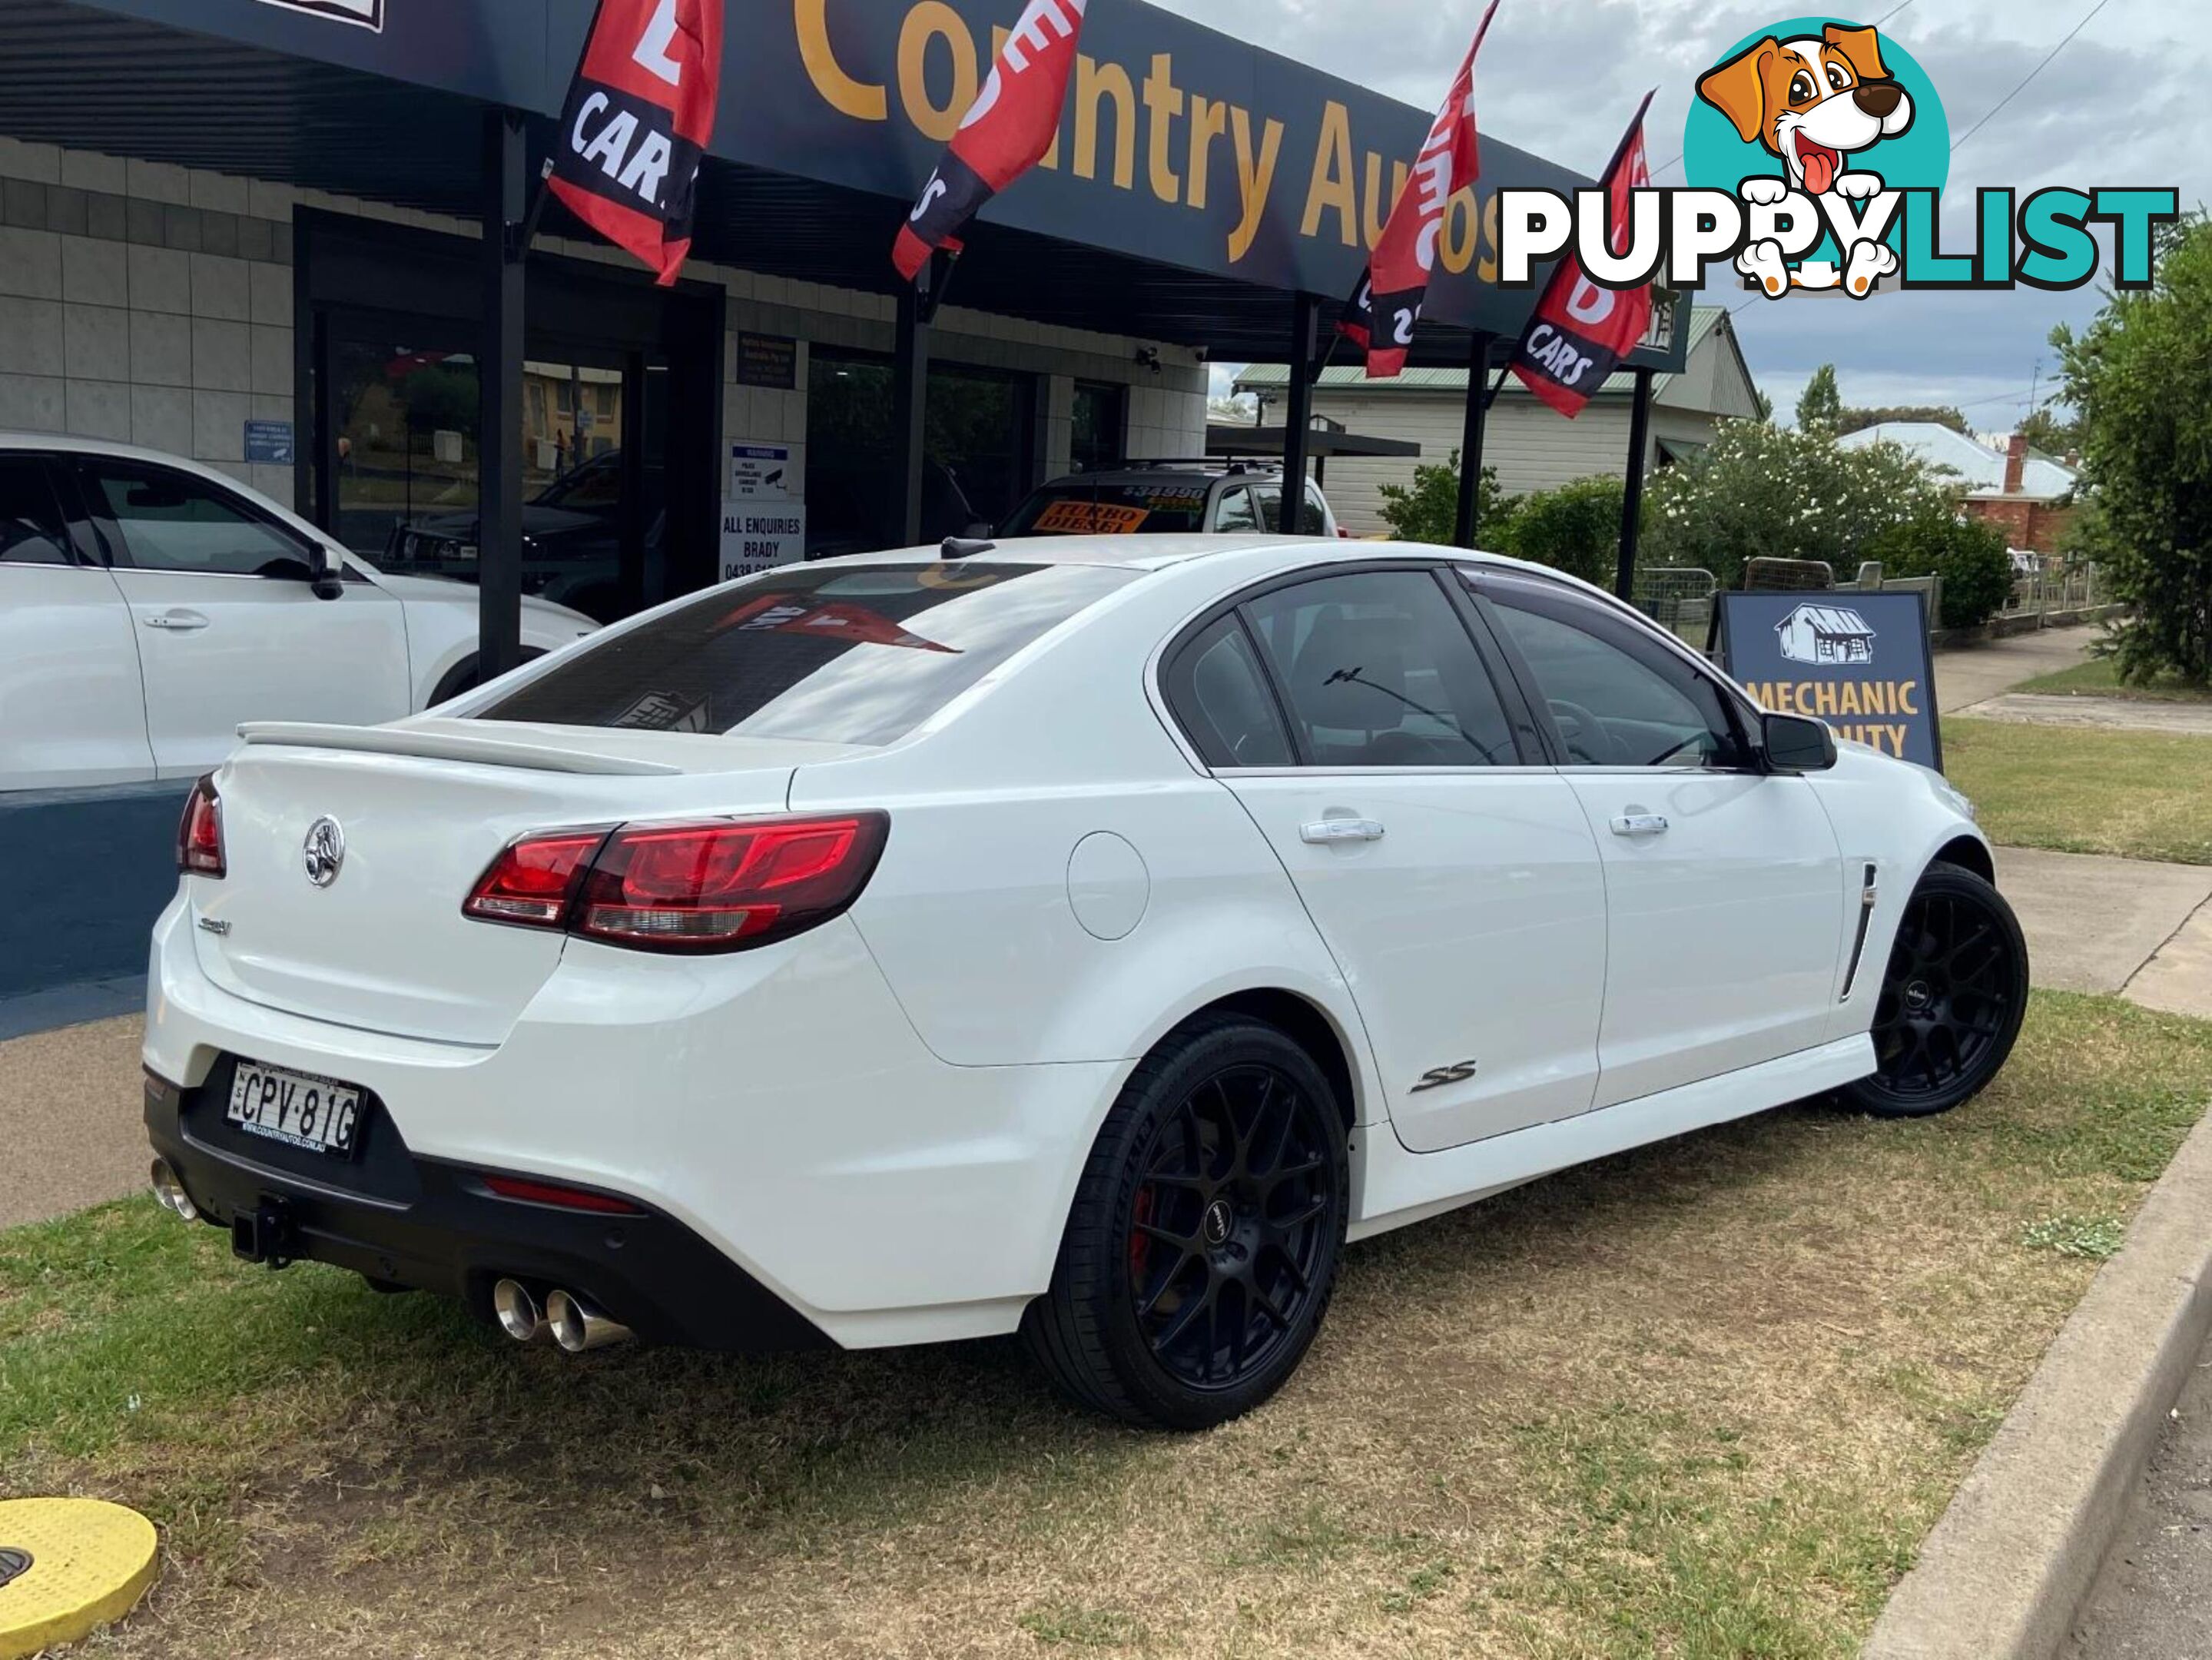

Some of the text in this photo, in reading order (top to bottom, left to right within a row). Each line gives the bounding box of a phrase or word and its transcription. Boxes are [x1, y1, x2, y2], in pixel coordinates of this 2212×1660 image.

[572, 91, 676, 209] CAR
[1527, 324, 1593, 385] CARS
[724, 516, 800, 536] ALL ENQUIRIES
[1054, 503, 1136, 522] TURBO
[744, 541, 779, 557] BRADY
[1746, 681, 1918, 715] MECHANIC
